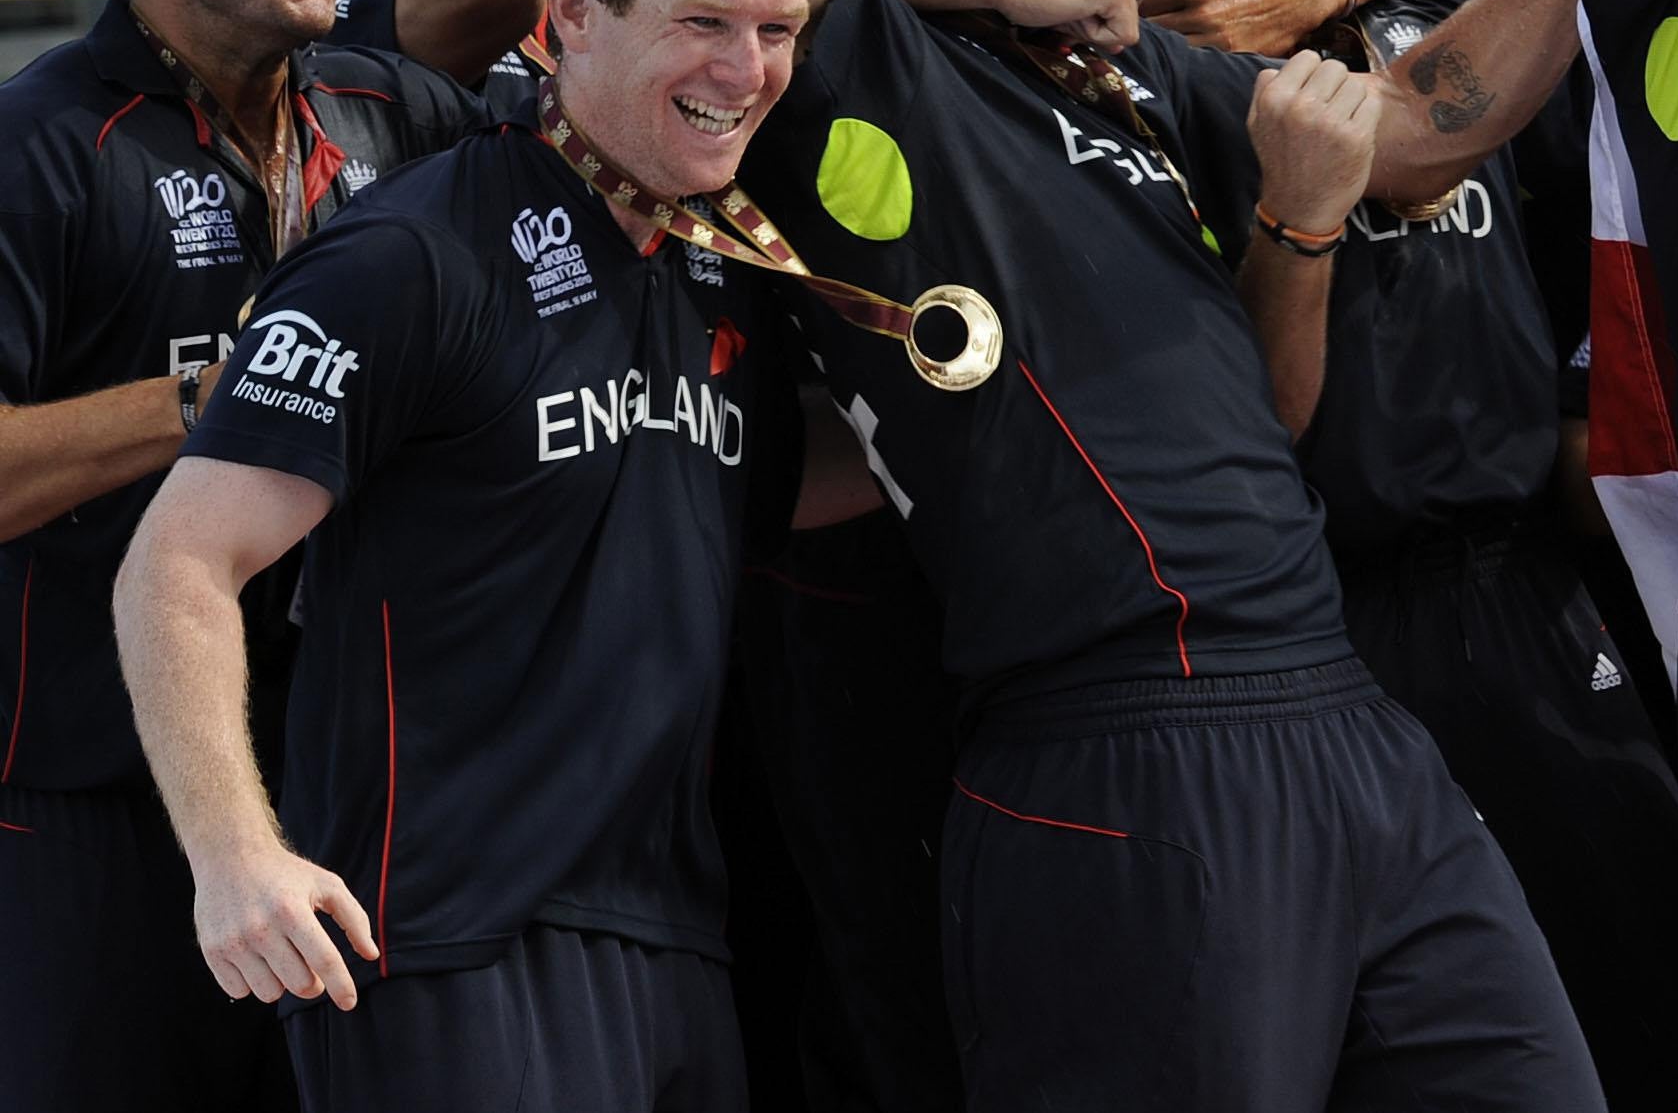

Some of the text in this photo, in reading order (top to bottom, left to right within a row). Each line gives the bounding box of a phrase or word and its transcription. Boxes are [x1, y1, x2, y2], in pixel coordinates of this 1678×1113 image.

[170, 224, 238, 243] TWENTY20
[188, 209, 232, 227] WORLD
[541, 243, 583, 270] WORLD
[526, 258, 588, 291] TWENTY20
[247, 323, 360, 398] Brit
[231, 373, 337, 425] Insurance
[536, 368, 743, 466] ENGLAND
